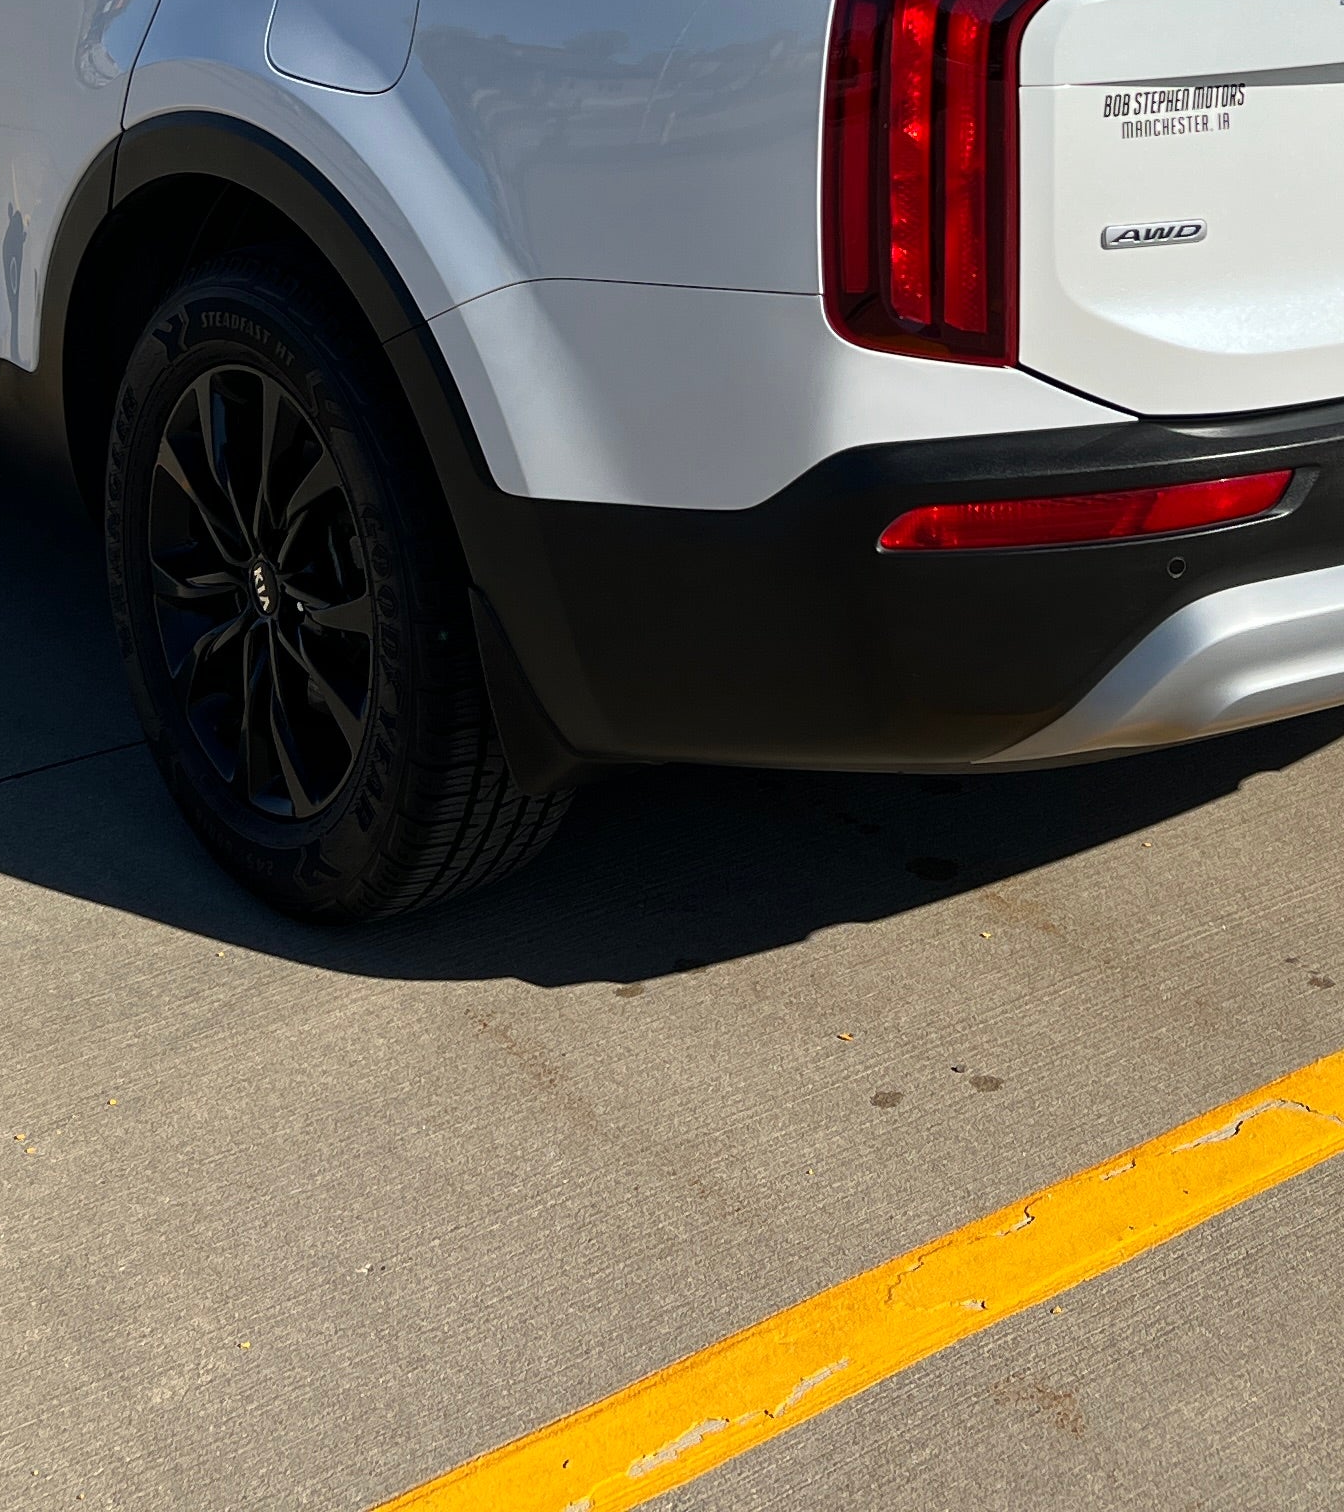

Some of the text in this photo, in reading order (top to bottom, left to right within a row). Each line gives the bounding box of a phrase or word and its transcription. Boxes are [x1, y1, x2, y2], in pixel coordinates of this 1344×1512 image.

[1103, 83, 1246, 118] BOB STEPHEN MOTORS
[1218, 112, 1231, 131] IA
[1109, 223, 1203, 243] AWD
[199, 310, 297, 368] STEADFAST HT
[252, 565, 272, 613] KIA
